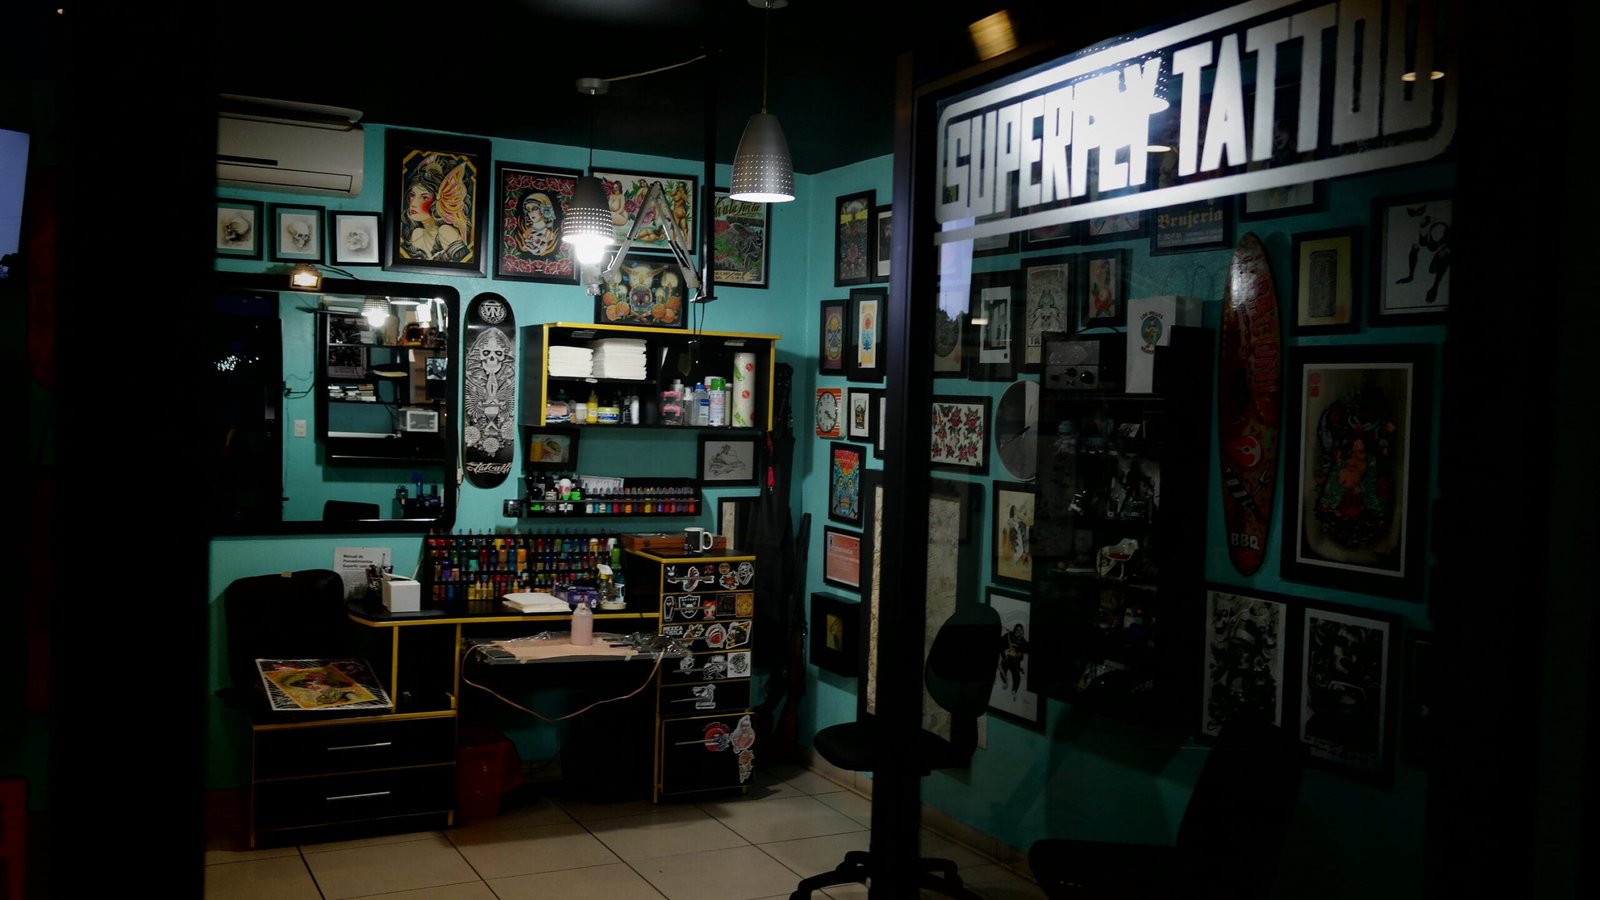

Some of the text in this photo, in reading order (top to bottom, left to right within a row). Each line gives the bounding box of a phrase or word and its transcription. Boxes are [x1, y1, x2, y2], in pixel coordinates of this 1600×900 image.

[943, 0, 1437, 219] SUPERFLY TATTOO
[1230, 532, 1260, 552] BBQ
